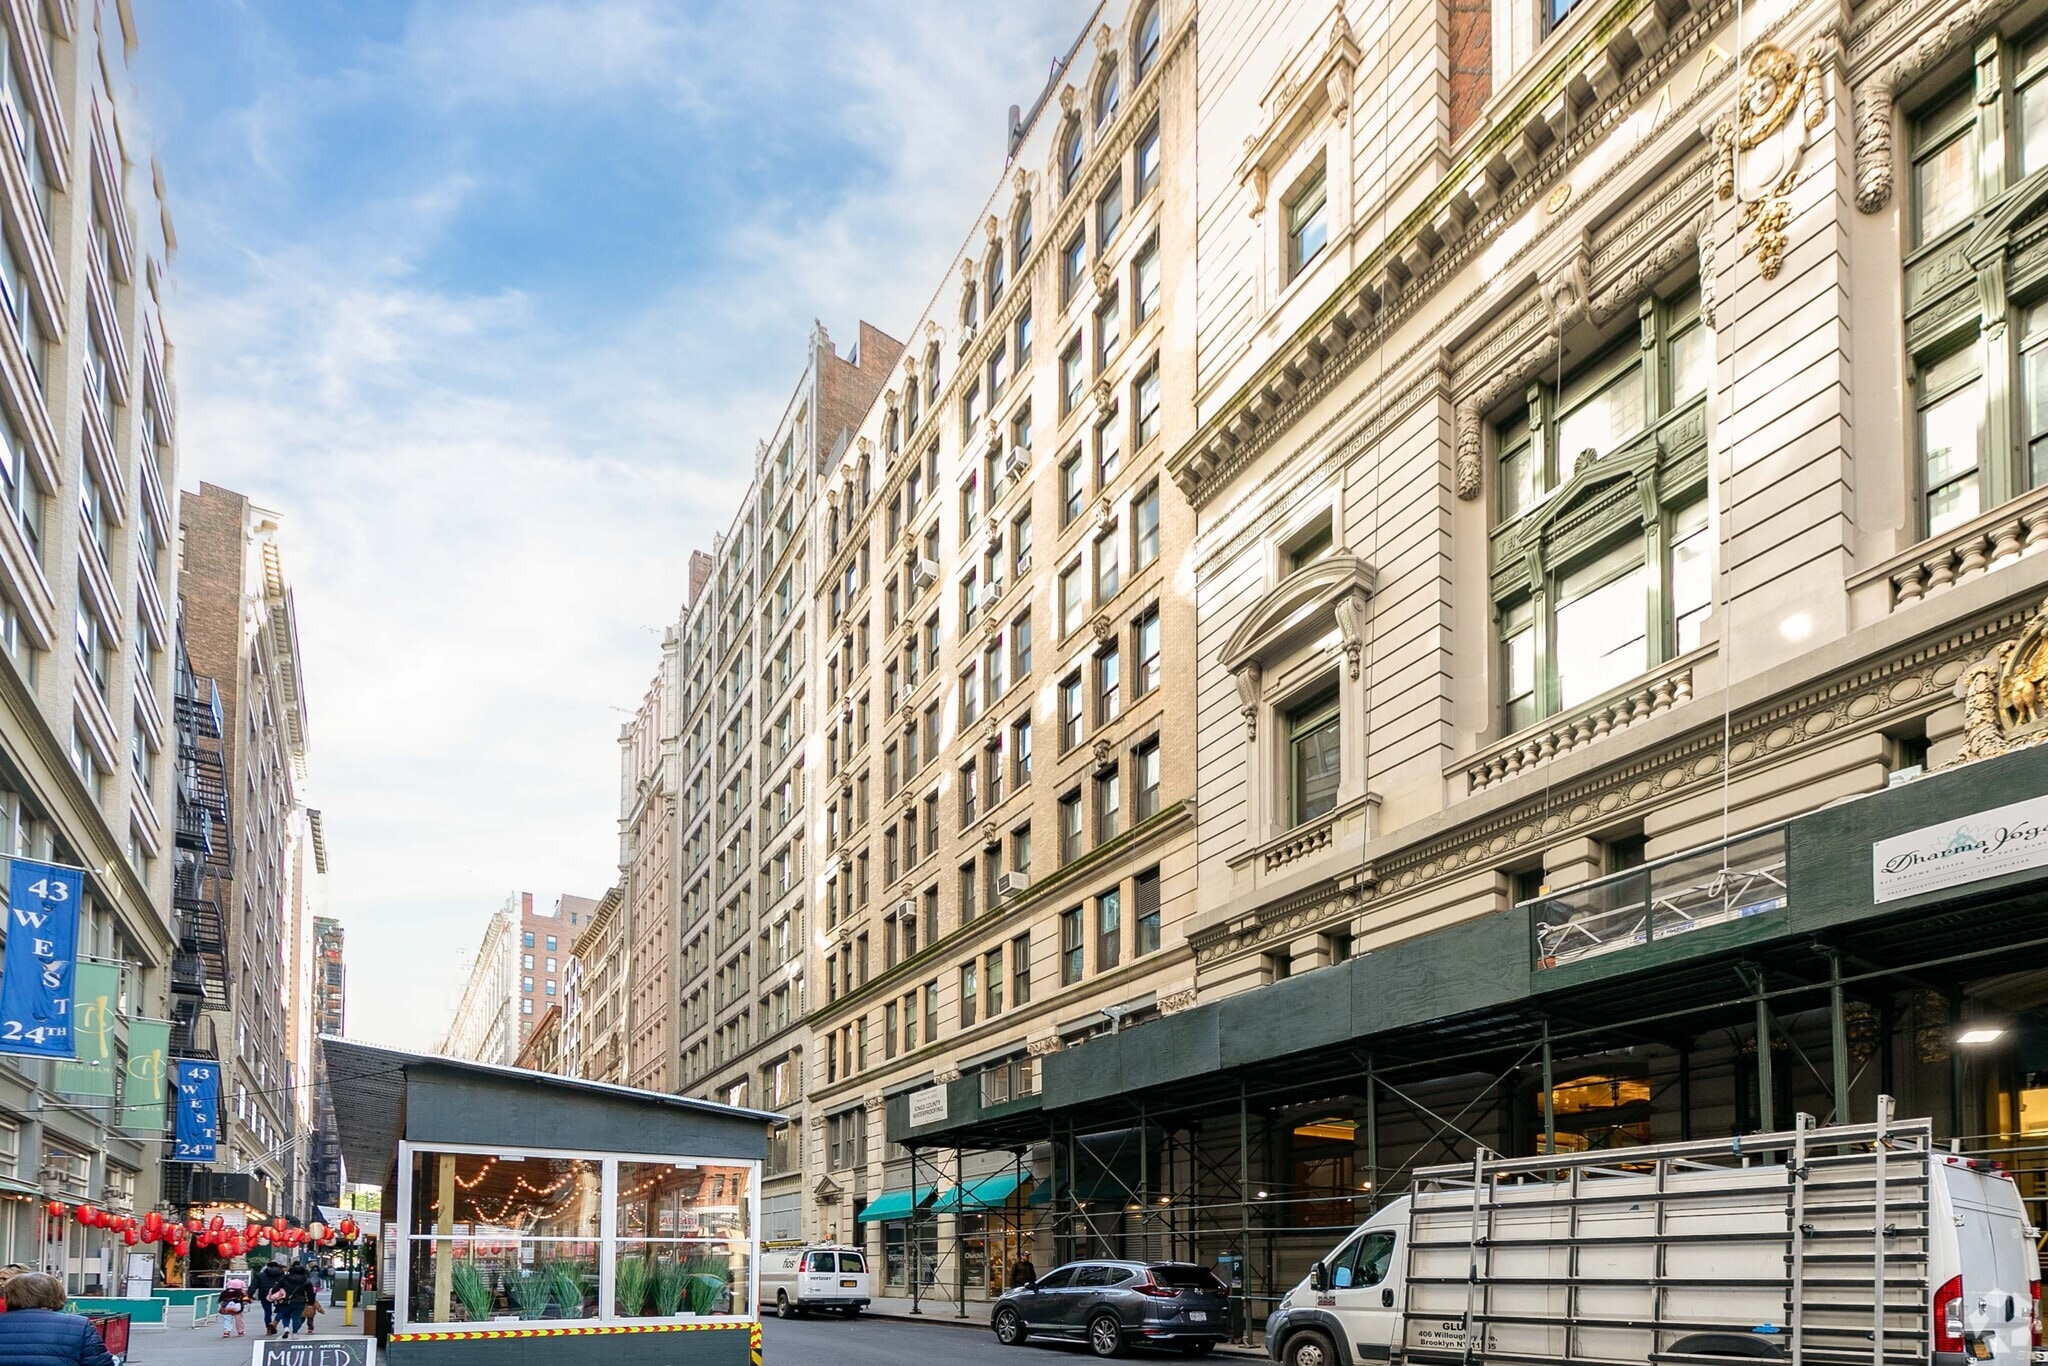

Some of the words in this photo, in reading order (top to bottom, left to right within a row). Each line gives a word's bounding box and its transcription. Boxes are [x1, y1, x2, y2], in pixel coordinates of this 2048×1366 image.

[1881, 840, 1987, 874] Dharma
[28, 878, 69, 901] 43
[1, 1020, 68, 1045] 24TH
[188, 1067, 210, 1080] 43
[1442, 1322, 1466, 1331] GLU
[1418, 1330, 1433, 1338] 406
[1434, 1331, 1478, 1342] Willoughy
[1420, 1338, 1455, 1348] Brooklyn
